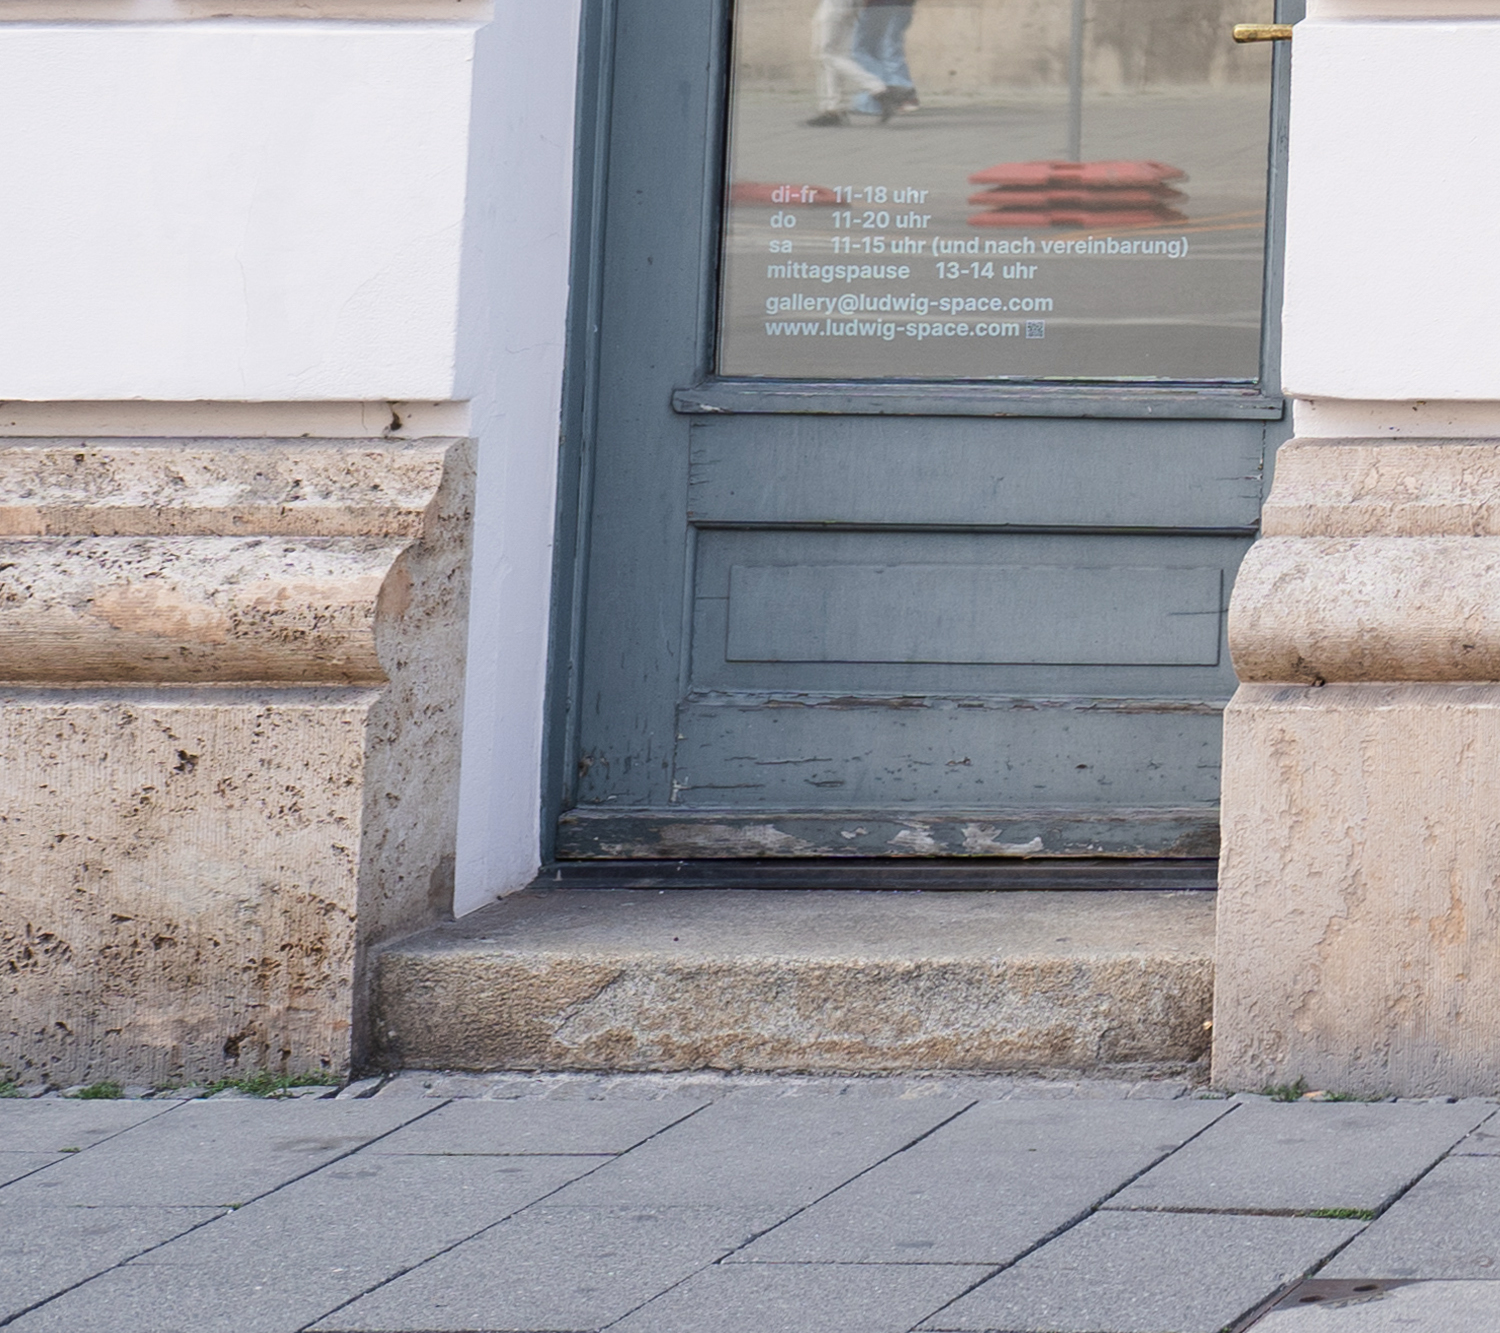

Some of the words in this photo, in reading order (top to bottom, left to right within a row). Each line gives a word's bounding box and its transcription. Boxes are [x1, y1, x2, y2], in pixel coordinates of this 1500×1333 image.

[771, 186, 818, 205] di-fr
[833, 186, 888, 205] 11-18
[893, 185, 929, 205] uhr
[769, 211, 797, 229] do
[831, 211, 890, 229] 11-20
[895, 210, 931, 229] uhr
[768, 239, 793, 255] sa
[830, 237, 886, 254] 11-15
[890, 236, 926, 255] uhr
[931, 235, 979, 257] (und
[984, 236, 1036, 255] nach
[1040, 235, 1189, 259] vereinbarung)
[767, 261, 910, 285] mittagspause
[935, 261, 995, 280] 13-14
[1002, 261, 1038, 280] uhr
[765, 292, 1054, 315] gallery@ludwig-space.com
[765, 318, 1021, 341] www.ludwig-space.com
